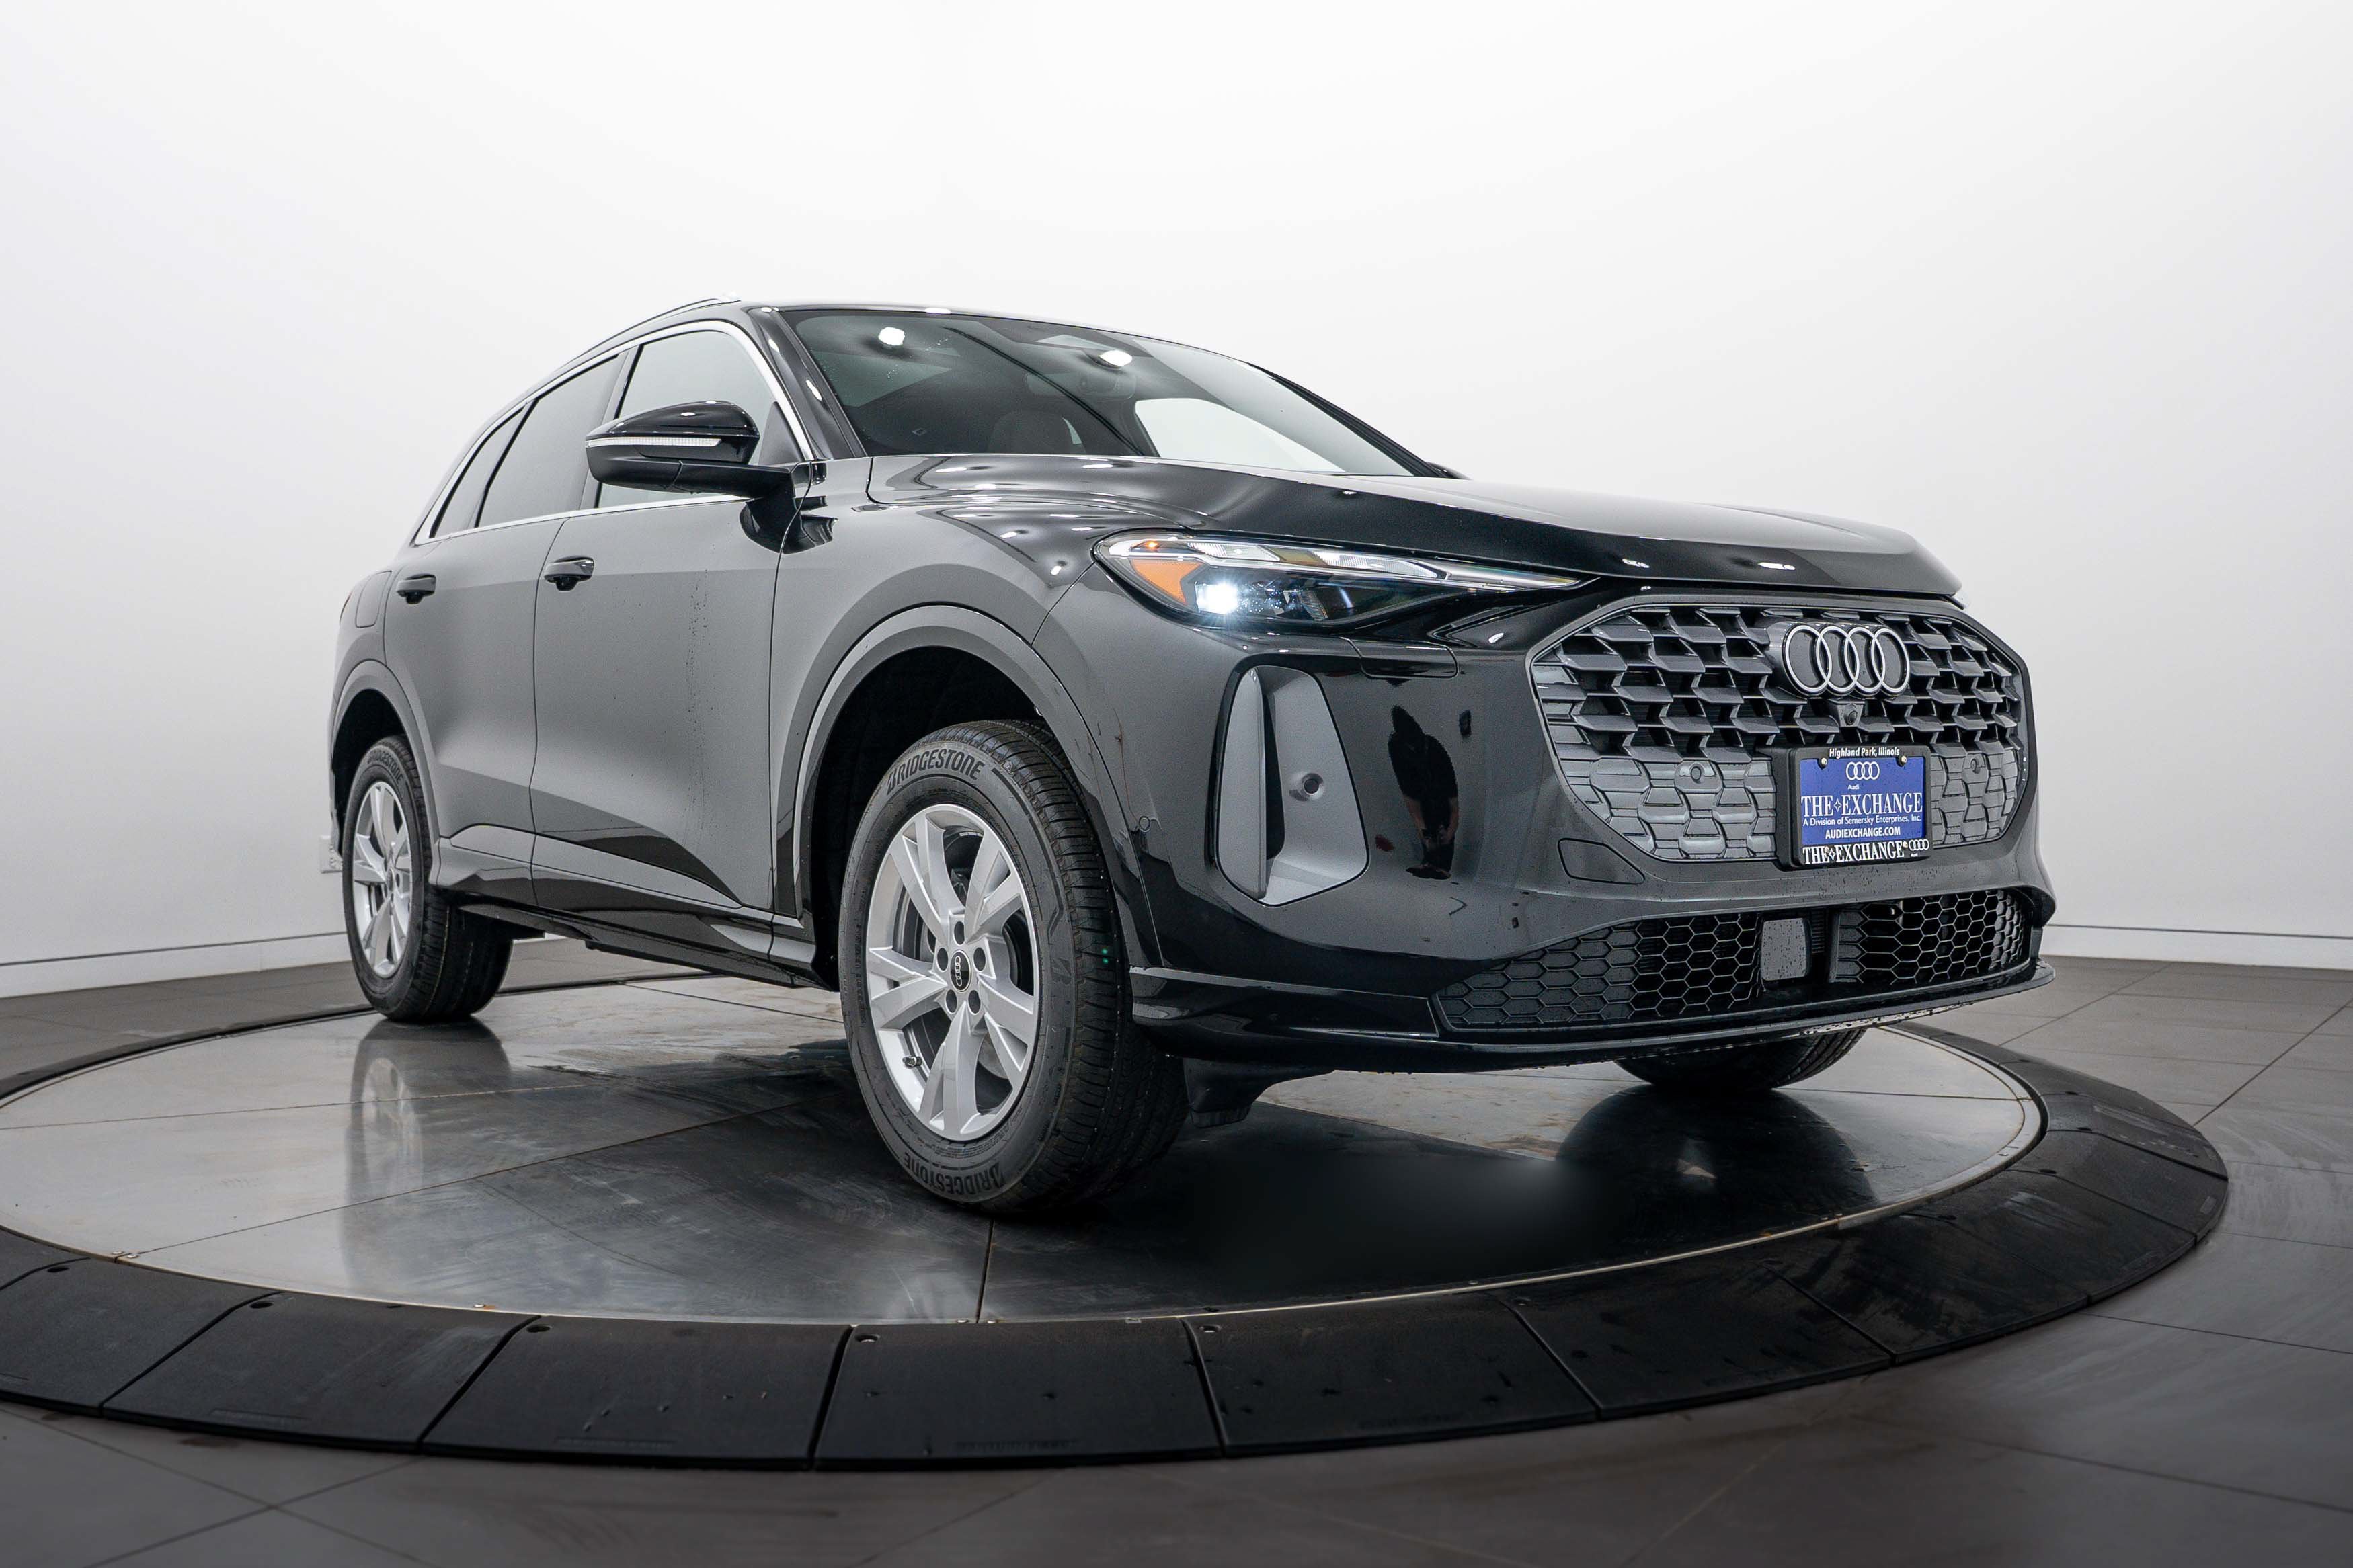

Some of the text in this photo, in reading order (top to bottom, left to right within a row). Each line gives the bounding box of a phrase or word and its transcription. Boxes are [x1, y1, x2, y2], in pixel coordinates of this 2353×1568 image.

[1829, 747, 1900, 759] Highland Park, Illinois
[887, 748, 986, 796] BRIDGESTONE
[1801, 792, 1923, 817] THE EXCHANGE
[1802, 818, 1809, 827] A
[1810, 817, 1835, 826] Division
[1837, 816, 1844, 825] of
[1845, 815, 1874, 826] Semersky
[1825, 826, 1901, 839] AUDIEXCHANGE.COM
[1802, 841, 1905, 865] THE EXCHANGE
